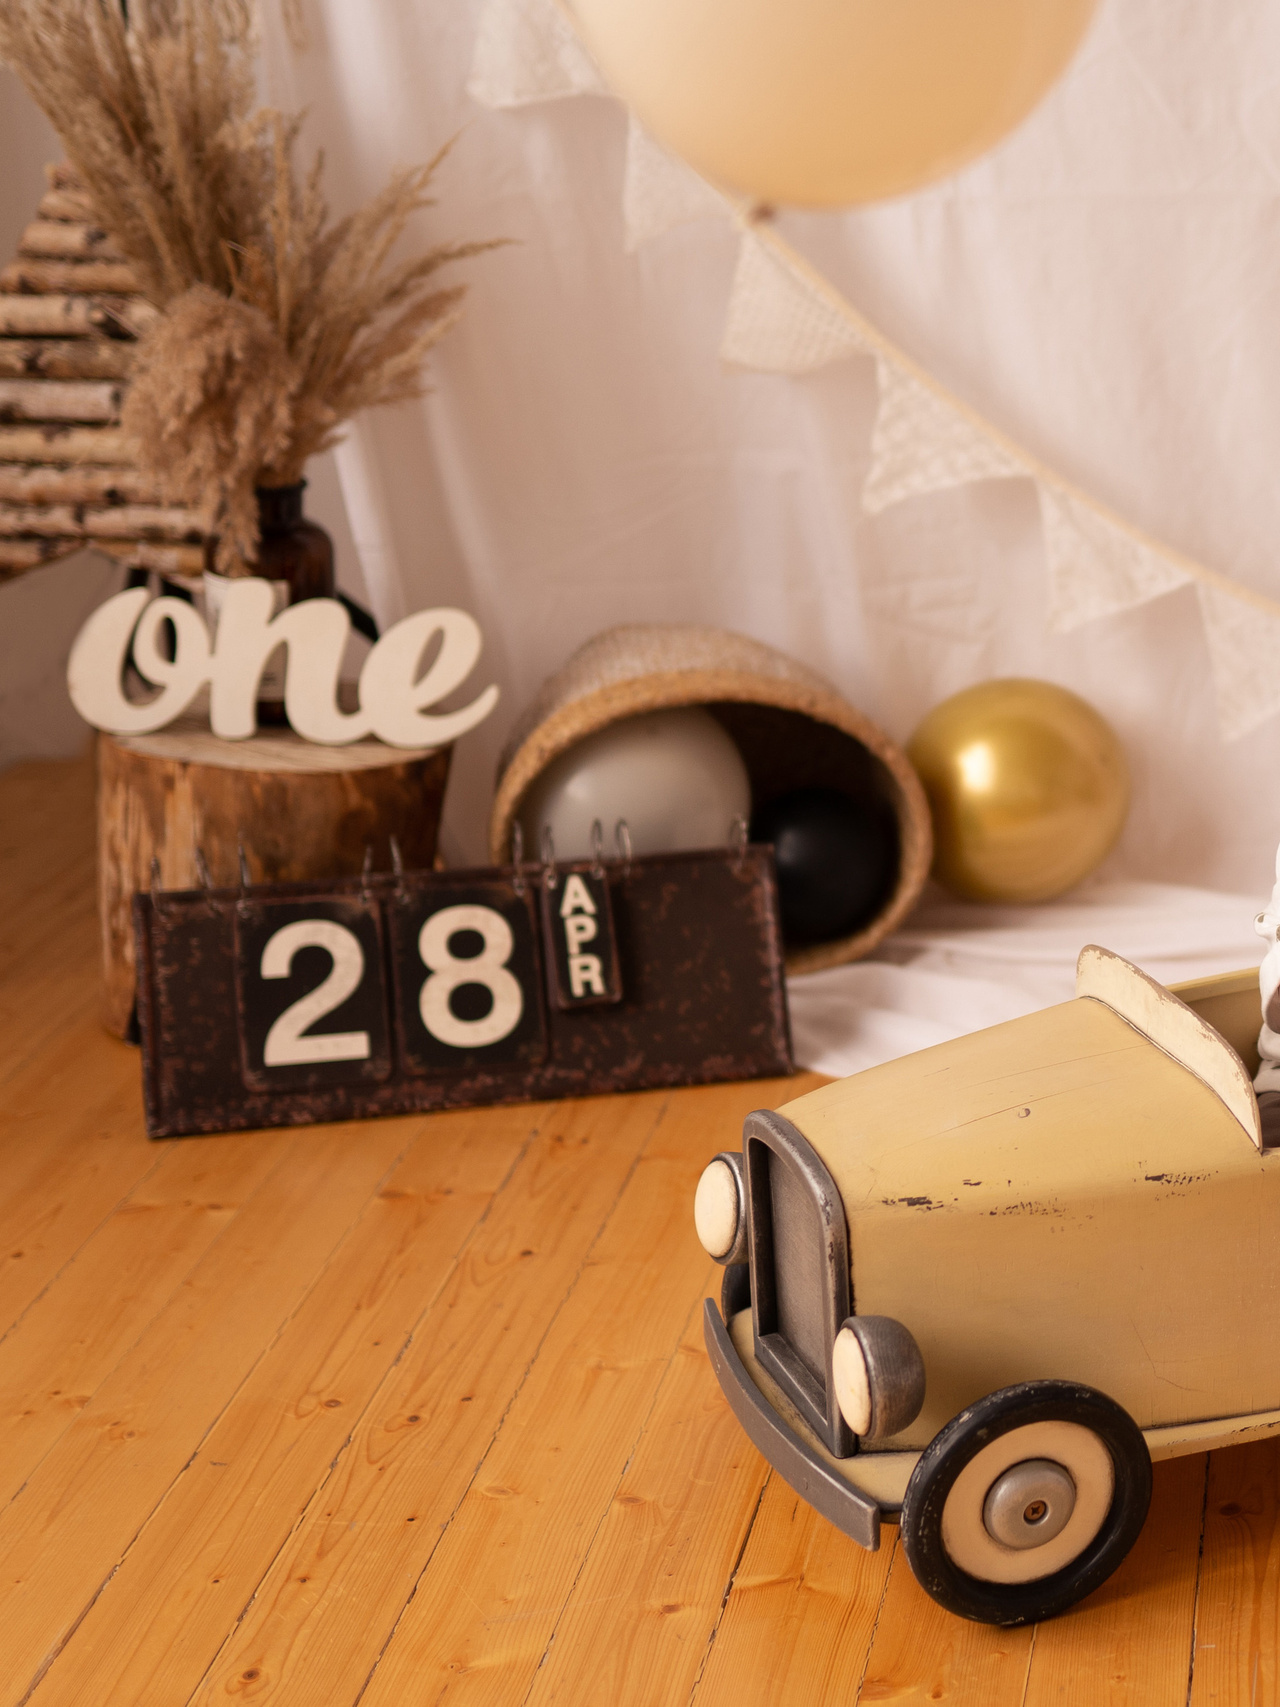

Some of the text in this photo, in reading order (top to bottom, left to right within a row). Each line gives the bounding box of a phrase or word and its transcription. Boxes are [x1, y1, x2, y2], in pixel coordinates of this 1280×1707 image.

[67, 577, 499, 748] one
[261, 874, 605, 1067] 28 APR
